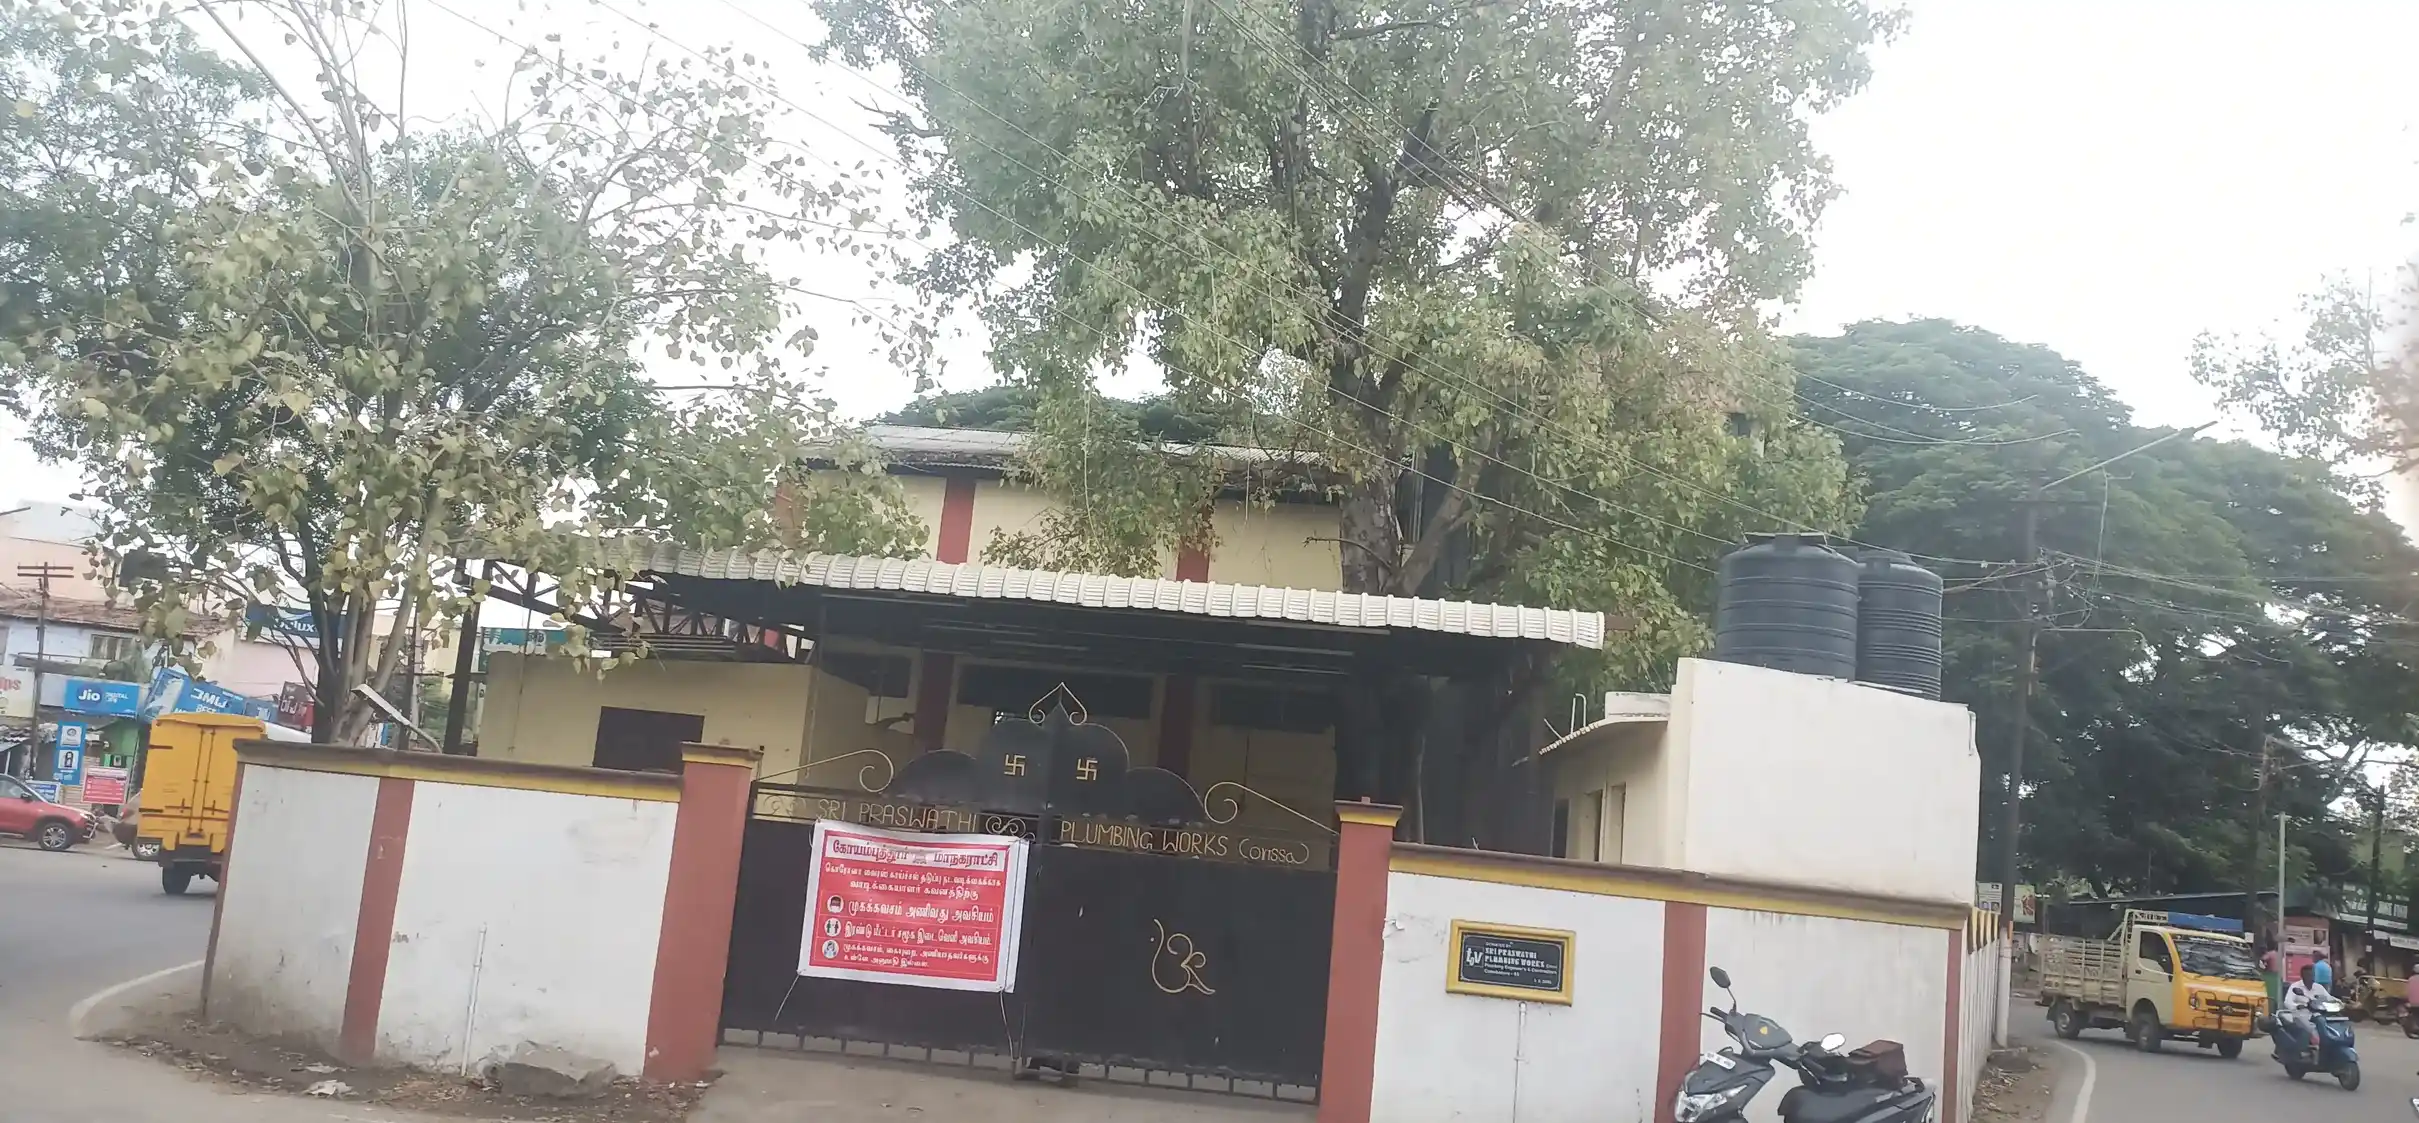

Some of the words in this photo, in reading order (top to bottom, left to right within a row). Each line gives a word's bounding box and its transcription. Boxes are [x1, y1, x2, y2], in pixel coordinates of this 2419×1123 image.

[78, 689, 100, 701] Jio
[818, 799, 846, 820] SRI
[859, 803, 977, 833] PRASWATHI
[1060, 820, 1153, 849] PLUMBING
[1163, 830, 1228, 857] WORKS
[833, 839, 908, 863] கோயம்புத்தூர்
[934, 850, 998, 867] மாநகராட்சி
[825, 862, 862, 875] கொரோனா
[850, 880, 921, 894] வாடிக்கையாளர்
[924, 885, 979, 901] கவனத்திற்கு
[848, 898, 902, 916] முகக்கவசம்
[906, 902, 949, 923] அணிவது
[952, 904, 994, 923] அவசியம்
[844, 920, 872, 938] இரண்டு
[874, 922, 896, 937] மீட்டர்
[898, 927, 915, 943] சமூக
